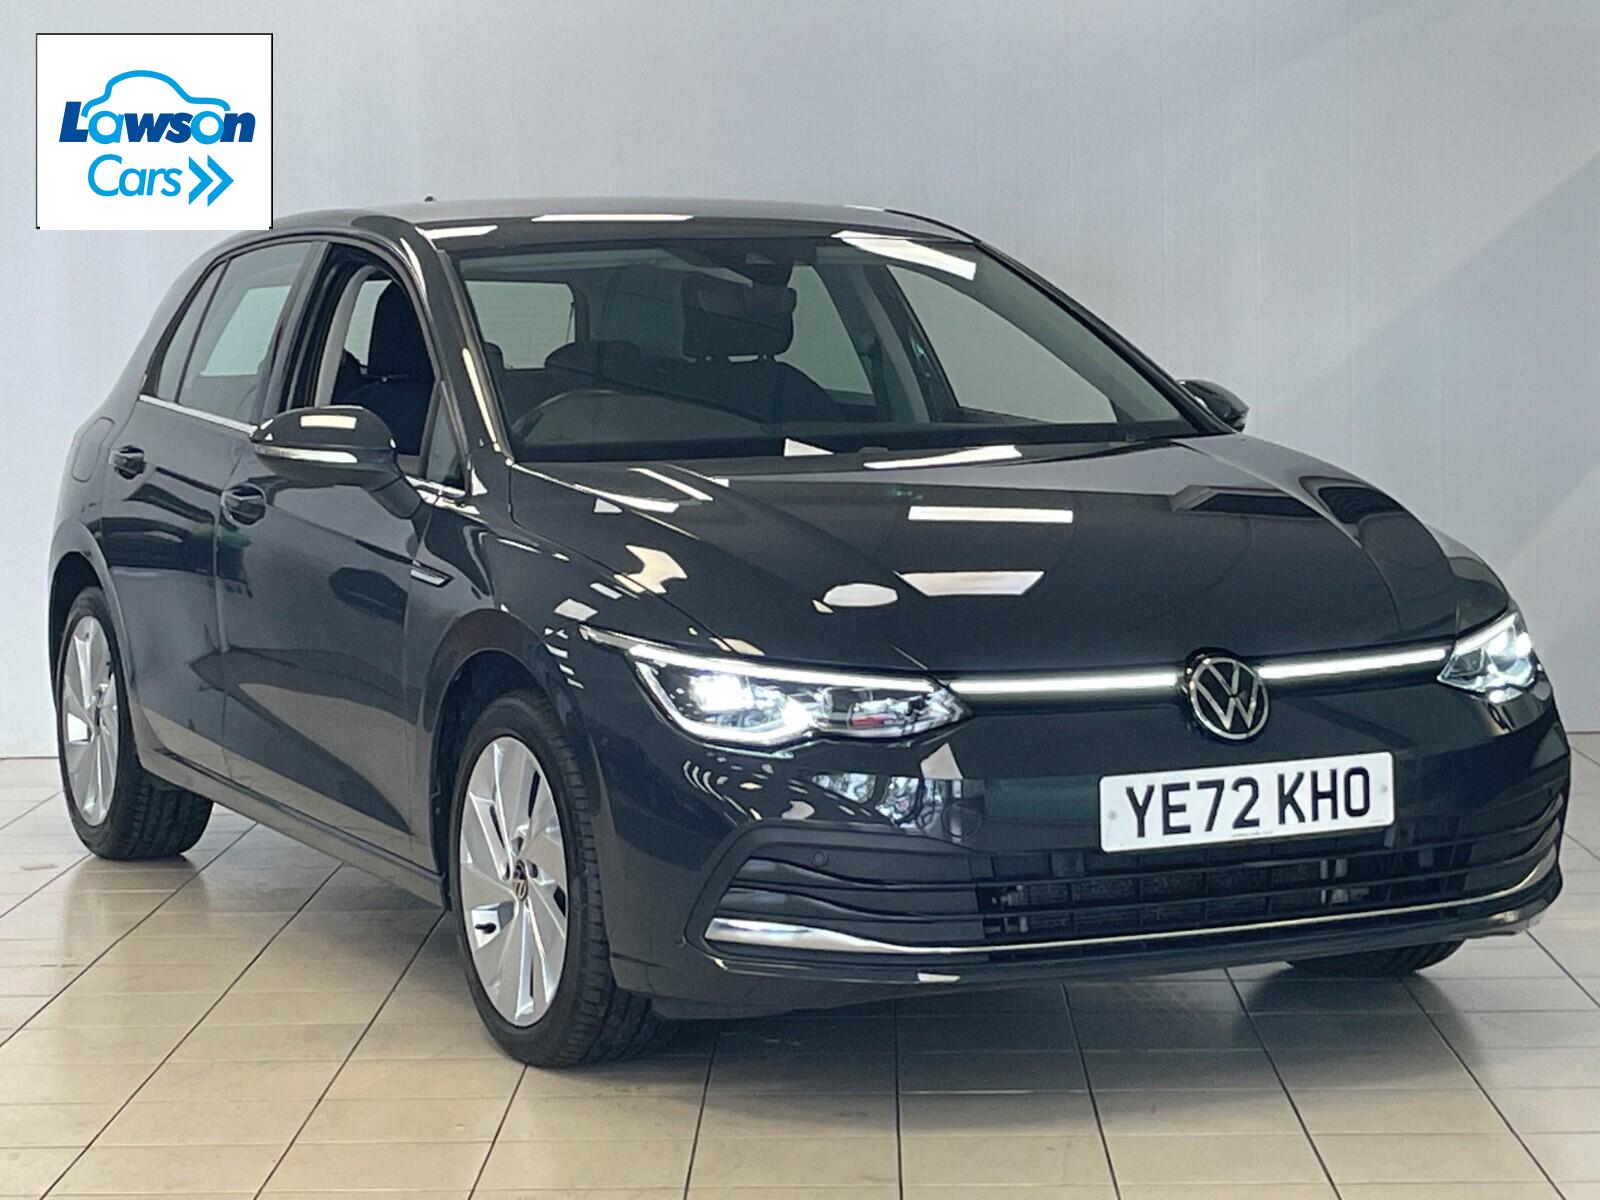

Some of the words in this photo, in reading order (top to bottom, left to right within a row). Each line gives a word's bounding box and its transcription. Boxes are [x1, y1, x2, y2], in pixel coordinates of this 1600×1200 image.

[1191, 658, 1264, 733] VW
[1125, 776, 1261, 838] YE72
[1277, 766, 1371, 825] KHO
